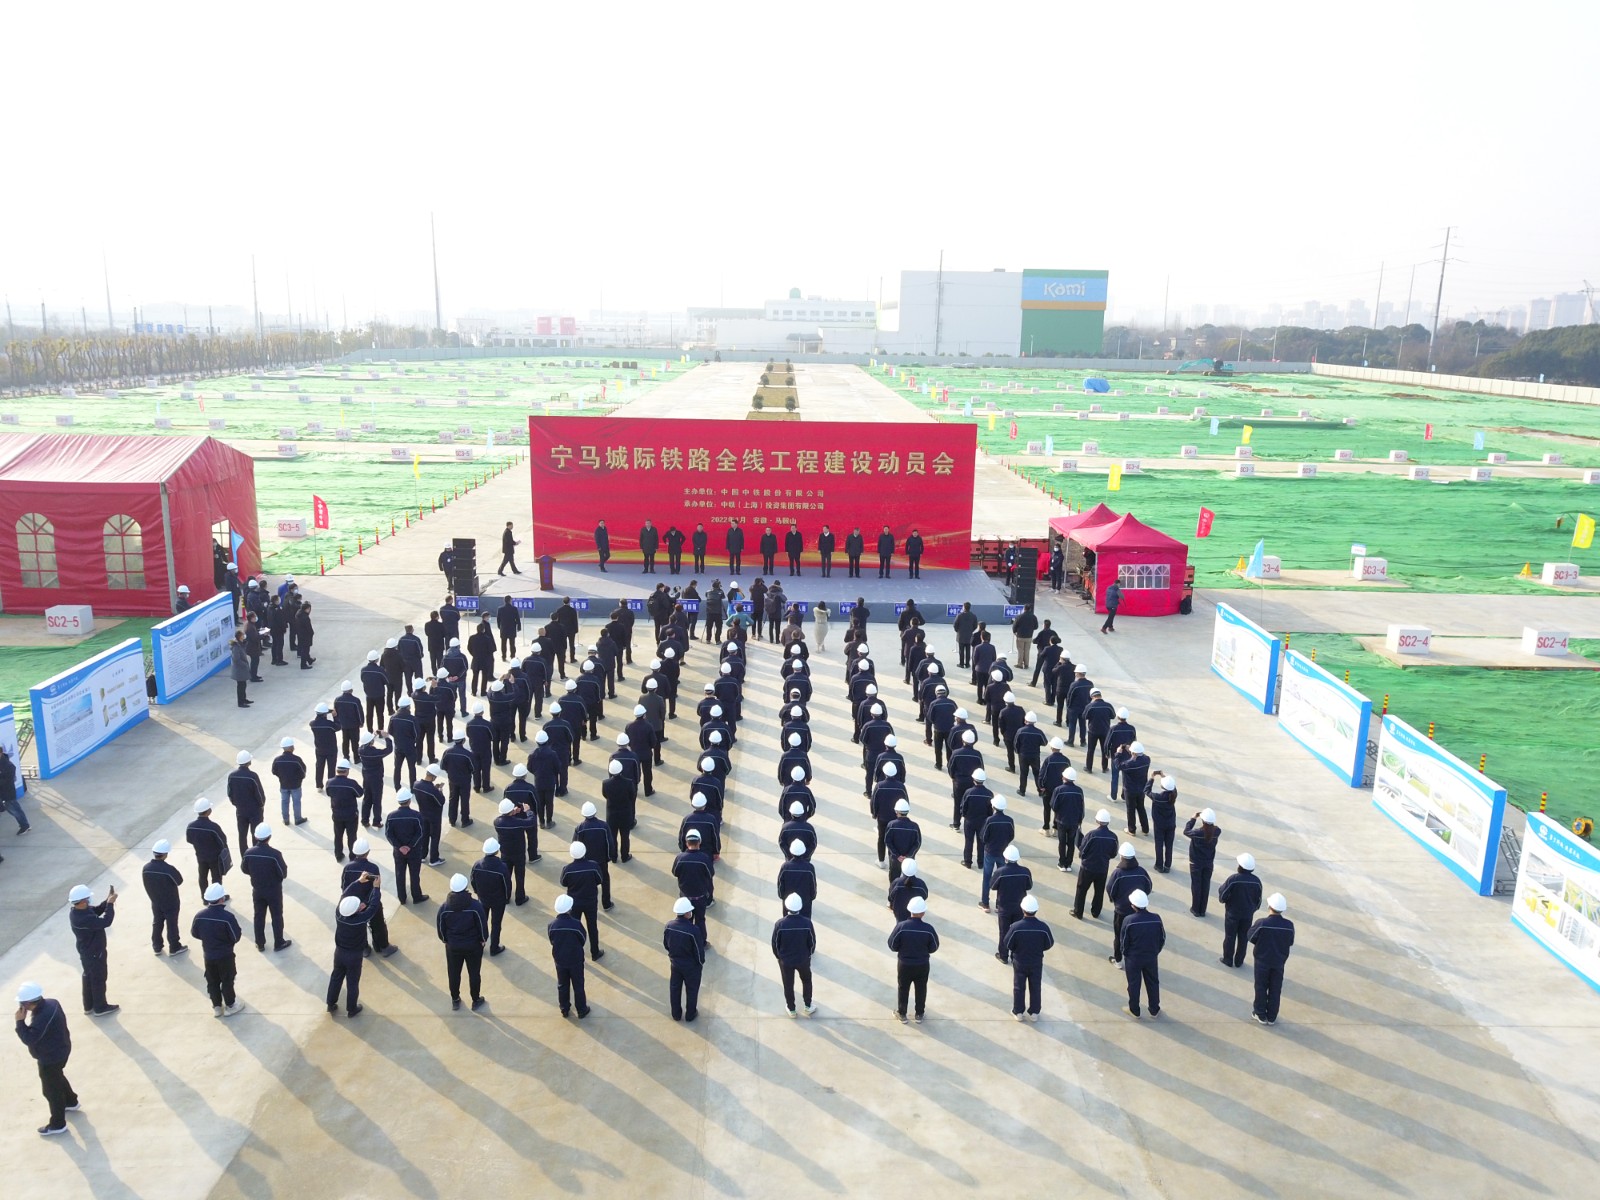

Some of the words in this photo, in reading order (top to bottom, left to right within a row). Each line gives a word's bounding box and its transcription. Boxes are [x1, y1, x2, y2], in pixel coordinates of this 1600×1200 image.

[550, 444, 955, 475] 宁马城际铁路全线工程建设动员会
[278, 523, 300, 532] SC3-5
[1262, 563, 1280, 573] C3-4
[1362, 565, 1386, 575] SC3-4
[1553, 570, 1578, 580] SC3-3
[47, 615, 80, 628] SC2-5
[1398, 635, 1429, 647] SC2-4
[1537, 636, 1568, 649] SC2-4
